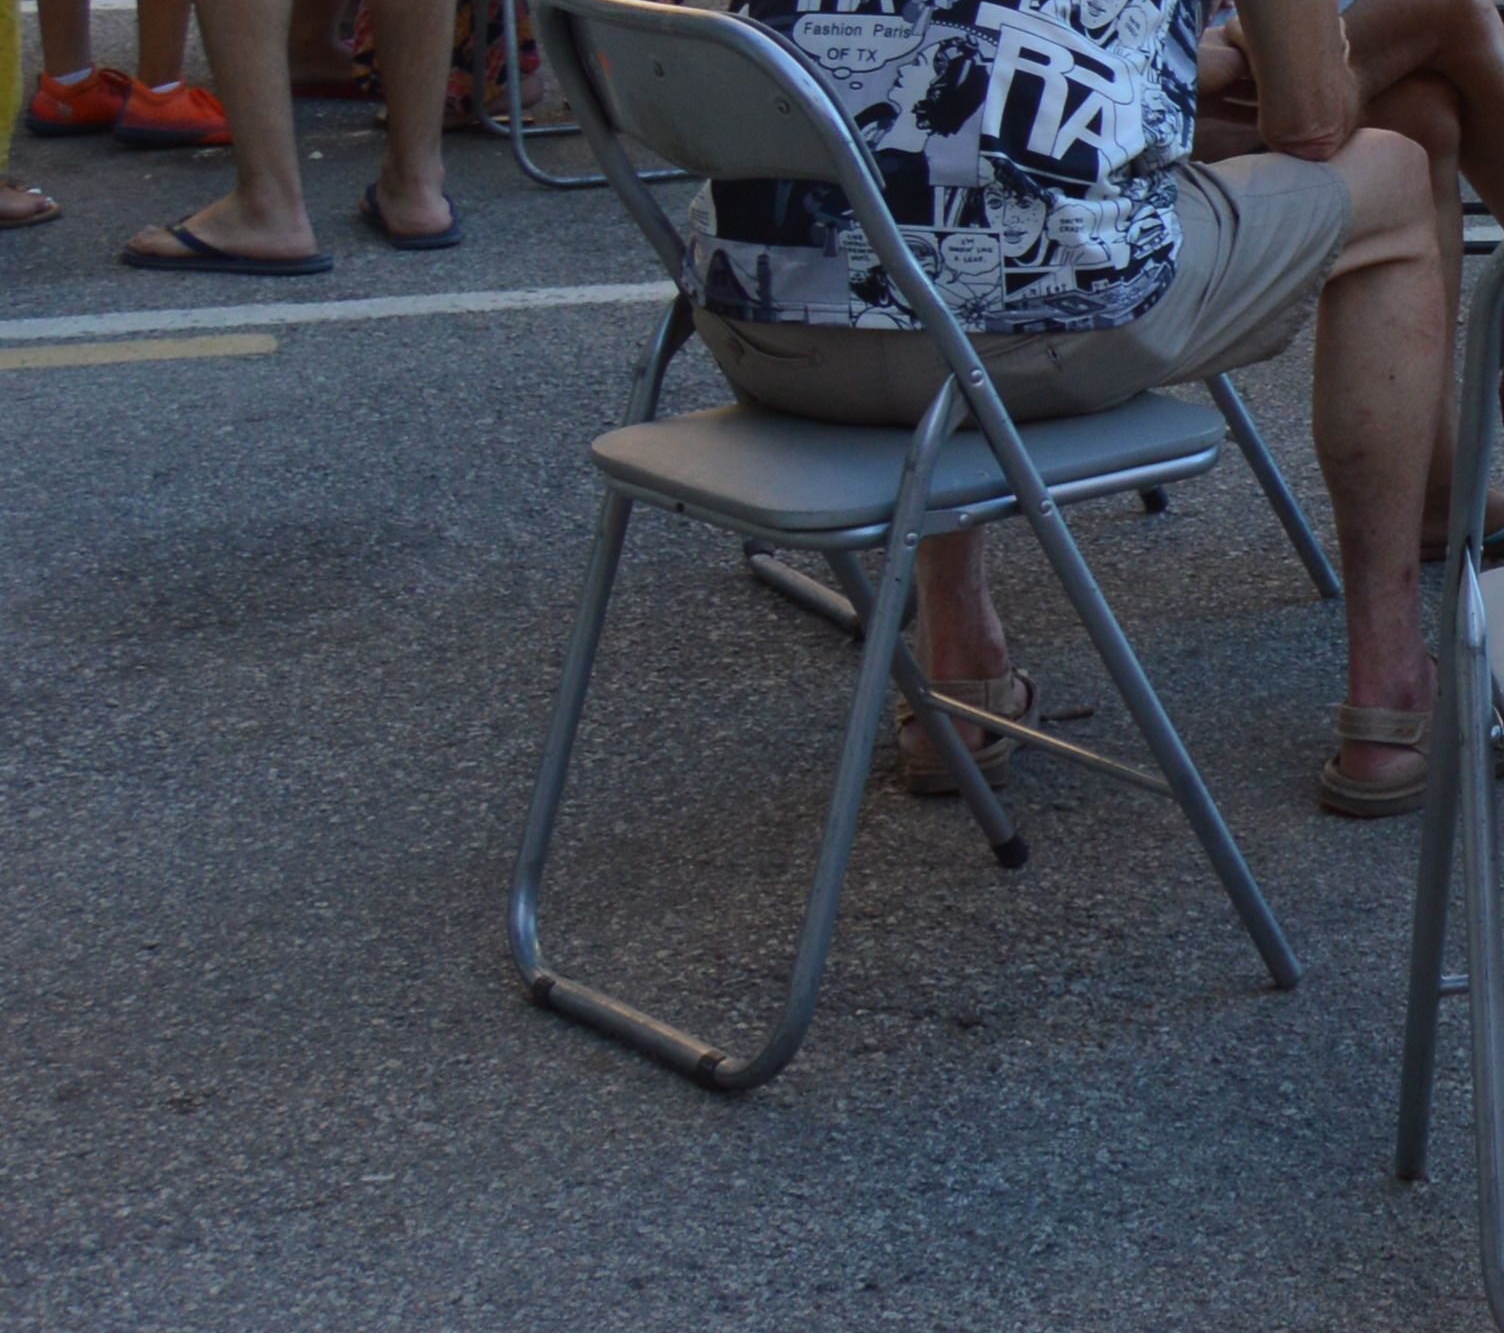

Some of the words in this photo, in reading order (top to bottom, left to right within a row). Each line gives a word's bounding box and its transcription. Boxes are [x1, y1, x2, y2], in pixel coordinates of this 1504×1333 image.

[803, 21, 863, 37] Fashion
[873, 23, 913, 39] Paris
[826, 47, 851, 61] OF
[856, 48, 879, 62] TX
